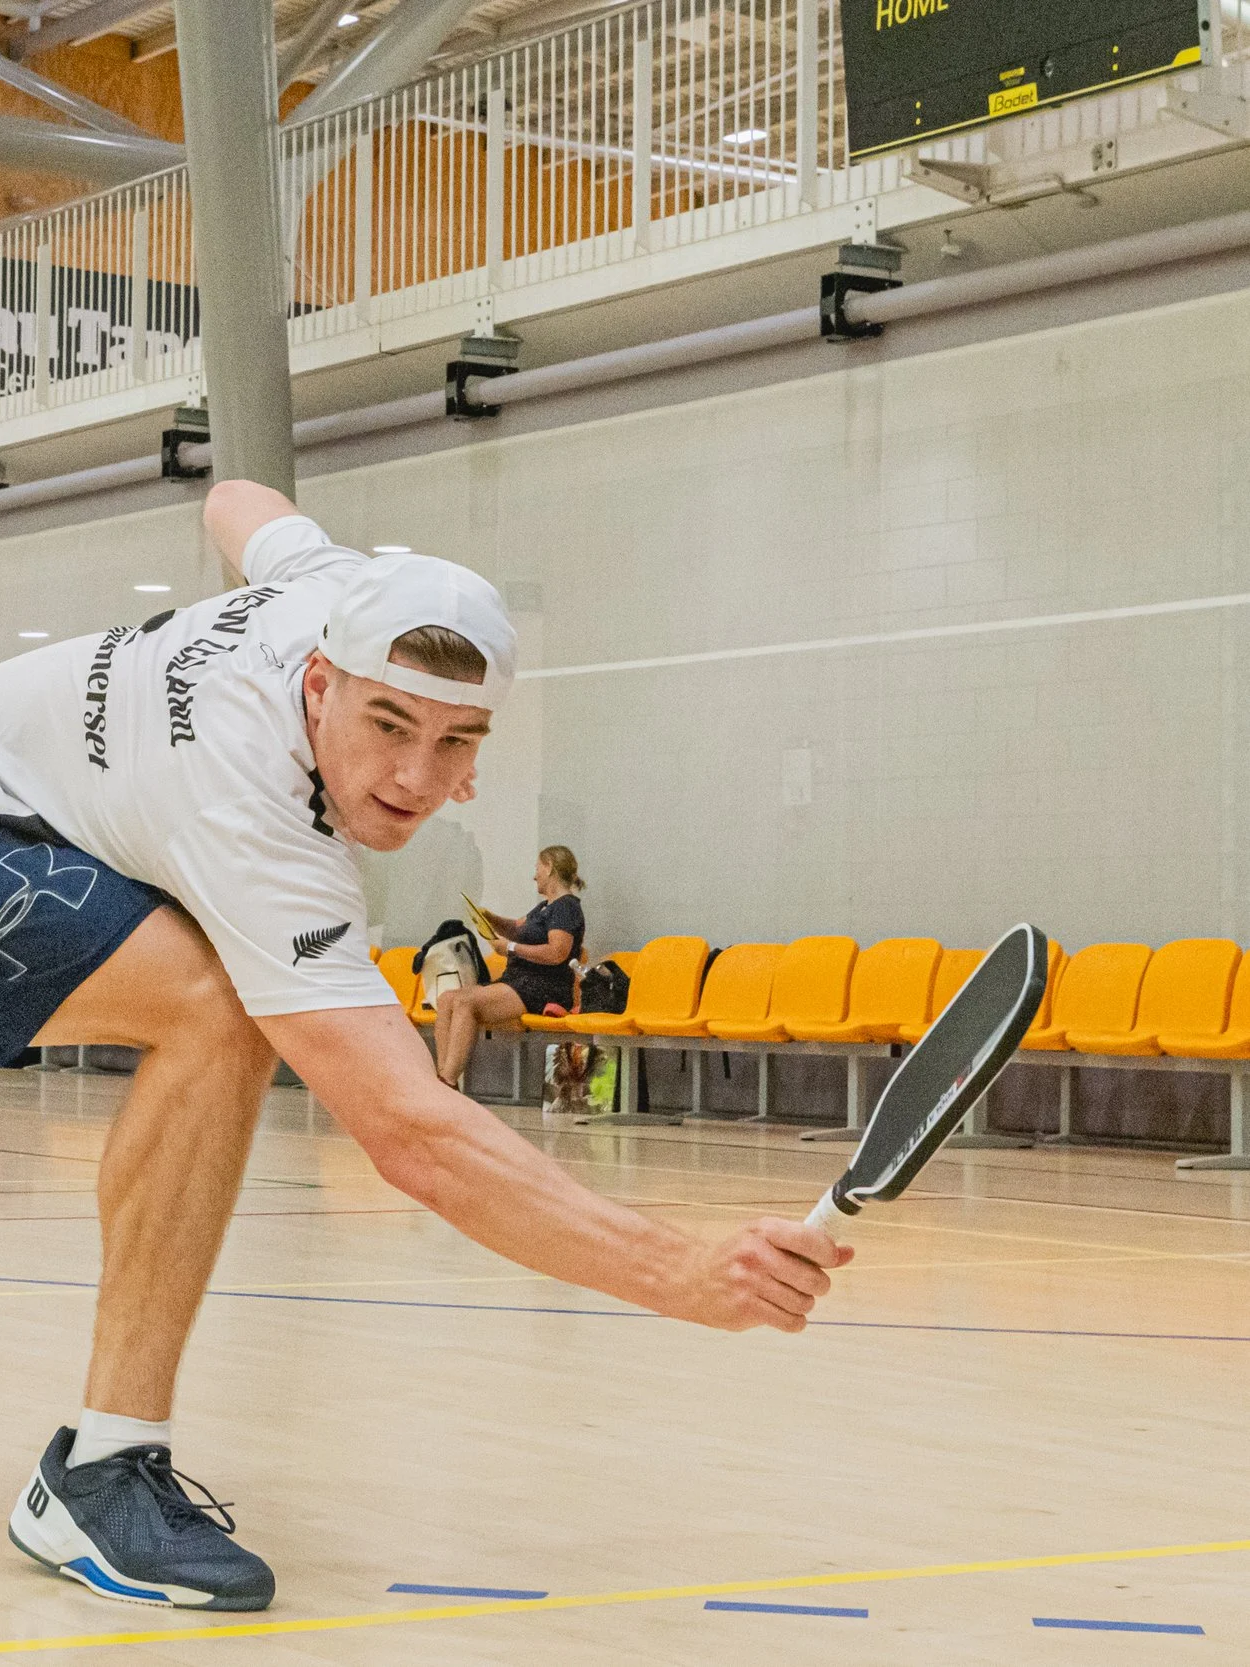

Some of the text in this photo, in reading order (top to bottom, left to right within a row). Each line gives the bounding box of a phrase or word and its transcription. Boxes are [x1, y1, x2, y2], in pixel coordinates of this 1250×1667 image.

[993, 90, 1034, 112] Bodet
[166, 587, 284, 747] NEW ZEALAND
